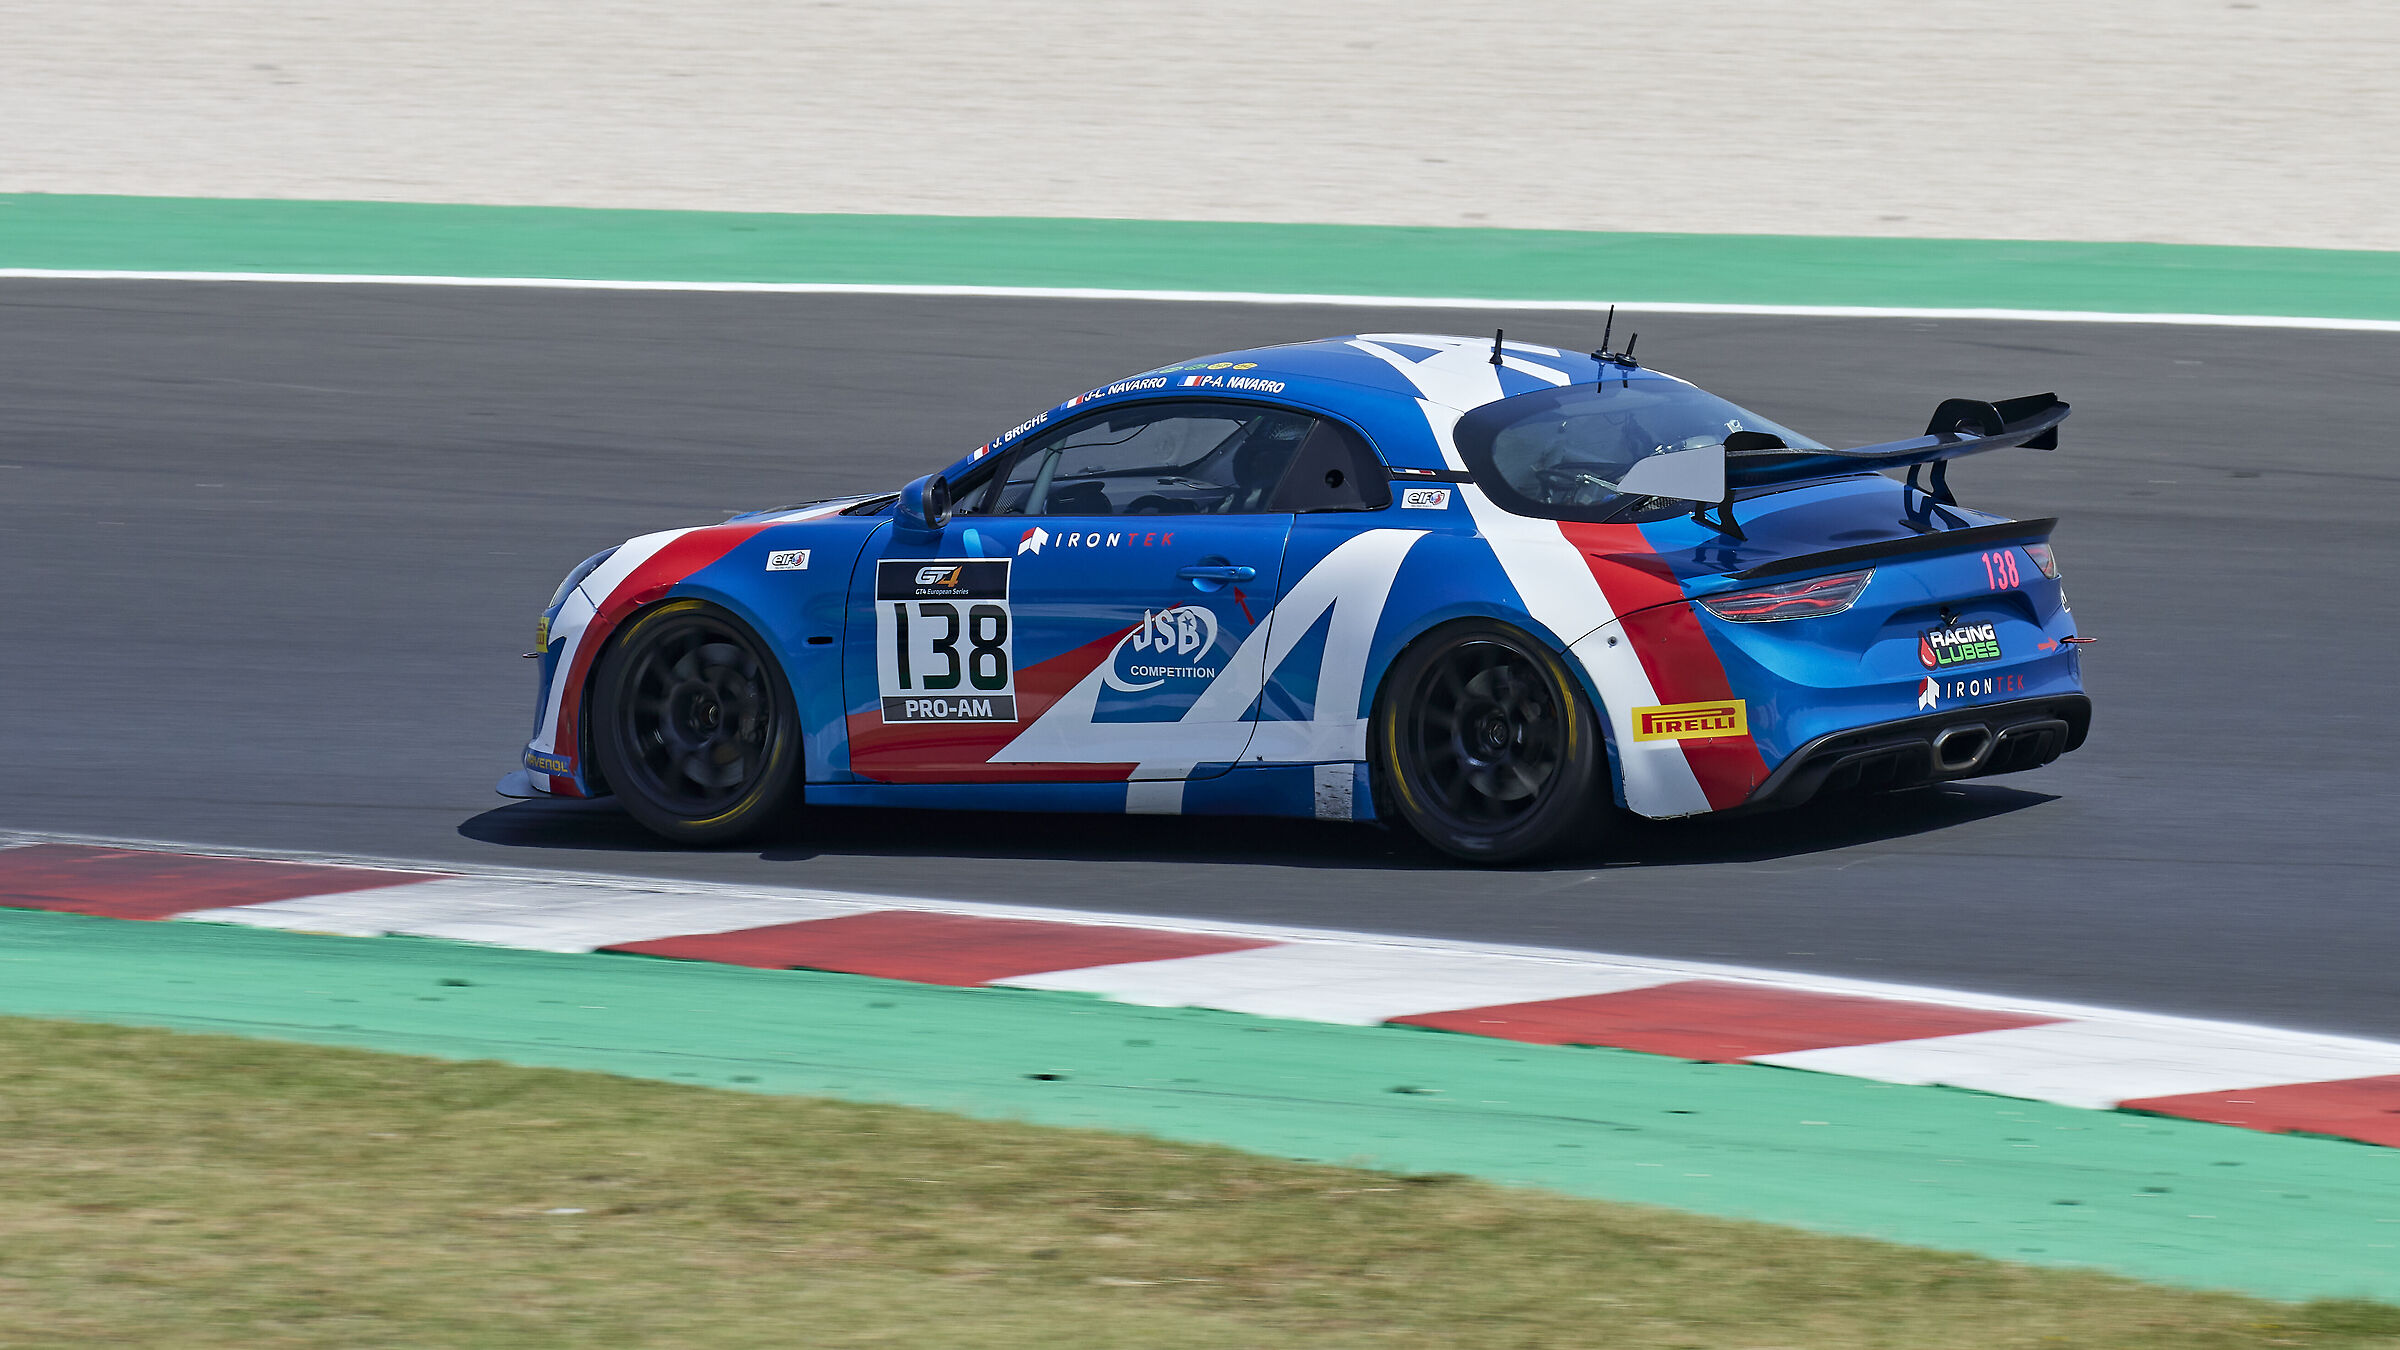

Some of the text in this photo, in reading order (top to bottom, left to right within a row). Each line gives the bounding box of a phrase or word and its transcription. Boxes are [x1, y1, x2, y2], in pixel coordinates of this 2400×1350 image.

[1107, 376, 1168, 396] NAVARRO
[1201, 375, 1286, 394] P-A. NAVARRO
[992, 410, 1049, 449] J. BRICHE
[1408, 491, 1432, 504] elf
[1055, 532, 1175, 548] IRONTEK
[914, 565, 963, 588] GT4
[1981, 550, 2020, 591] 138
[927, 588, 952, 596] European
[1132, 608, 1201, 656] JSB
[1930, 624, 1996, 648] RACING
[893, 602, 1008, 691] 138
[1936, 640, 2000, 665] LUBES
[1130, 665, 1215, 679] COMPETITION
[1946, 674, 2025, 699] IRONTEK
[904, 699, 993, 718] PRO-AM
[1641, 707, 1736, 735] PIRELLI
